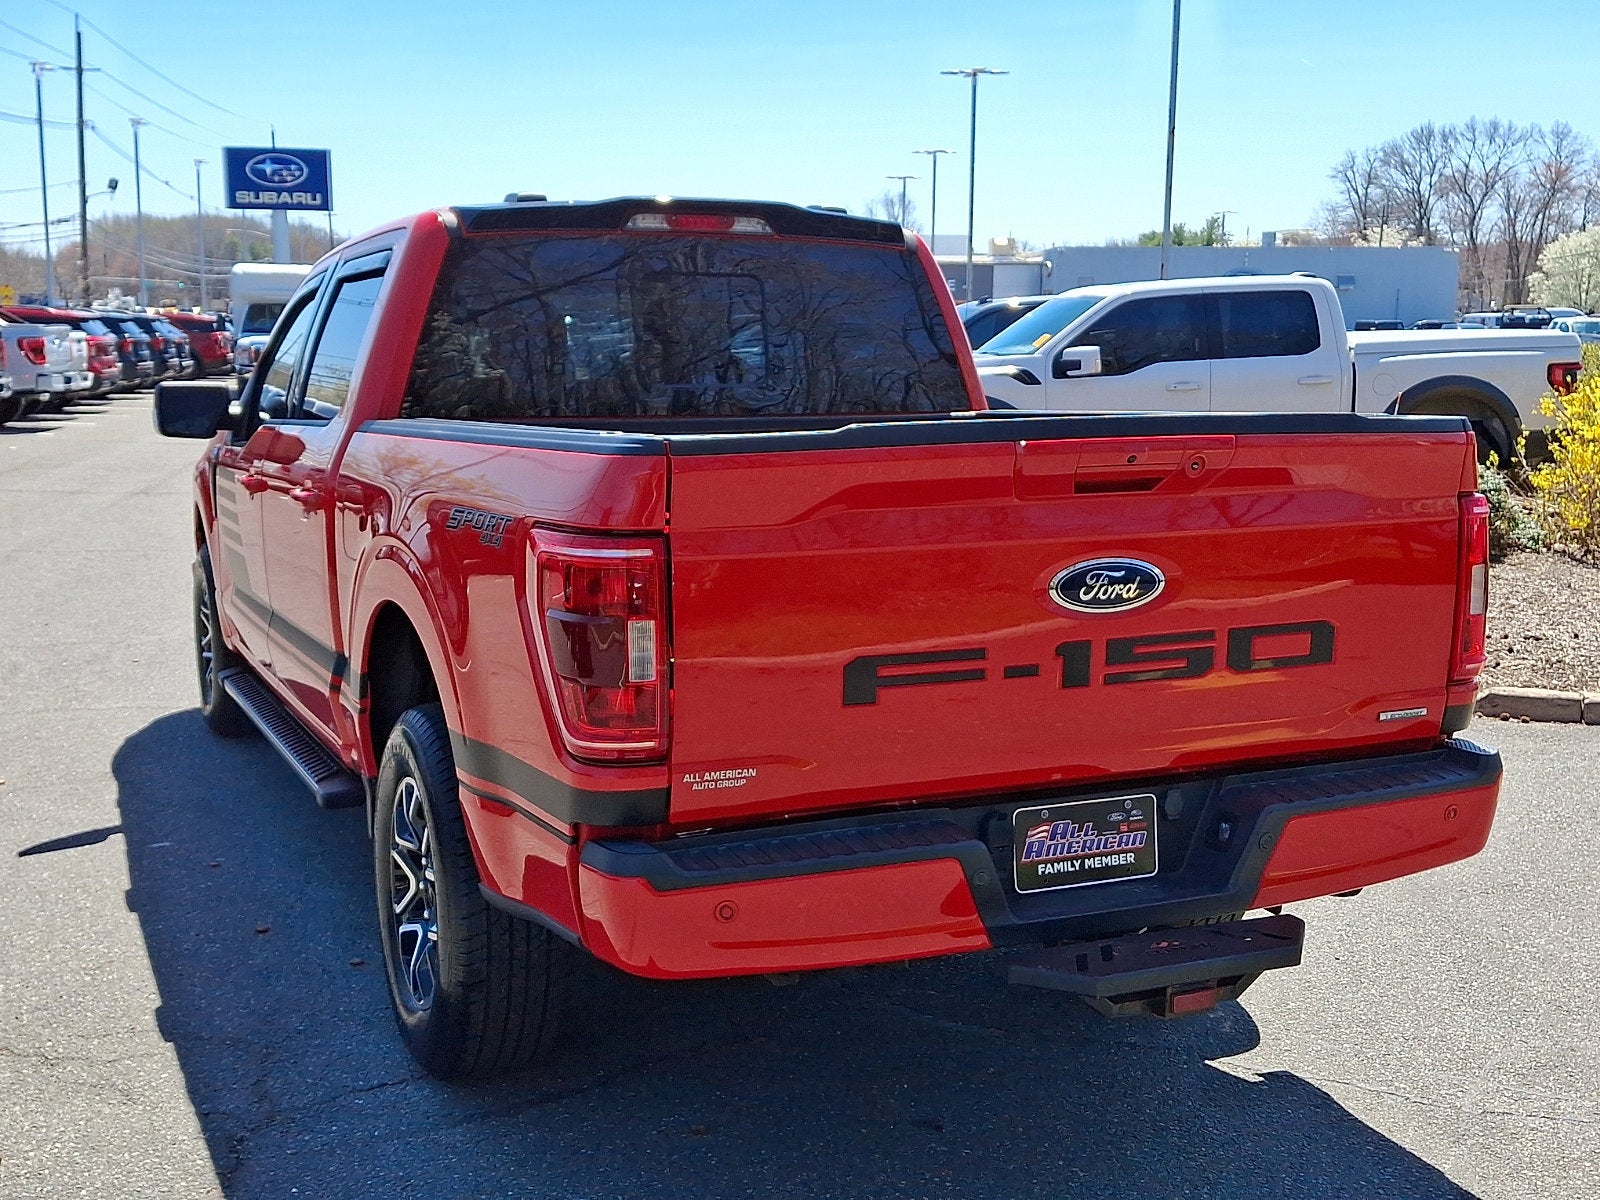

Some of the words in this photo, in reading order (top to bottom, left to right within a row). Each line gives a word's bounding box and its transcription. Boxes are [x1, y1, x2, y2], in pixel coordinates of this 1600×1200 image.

[235, 191, 321, 205] SUBARU
[447, 507, 512, 534] SPORT
[1079, 570, 1141, 601] Ford
[842, 620, 1335, 706] F-150
[683, 773, 702, 782] ALL
[703, 768, 757, 781] AMERICAN
[692, 781, 716, 790] AUTO
[717, 779, 747, 788] GROUP
[1037, 859, 1081, 875] FAMILY
[1085, 852, 1135, 869] MEMBER
